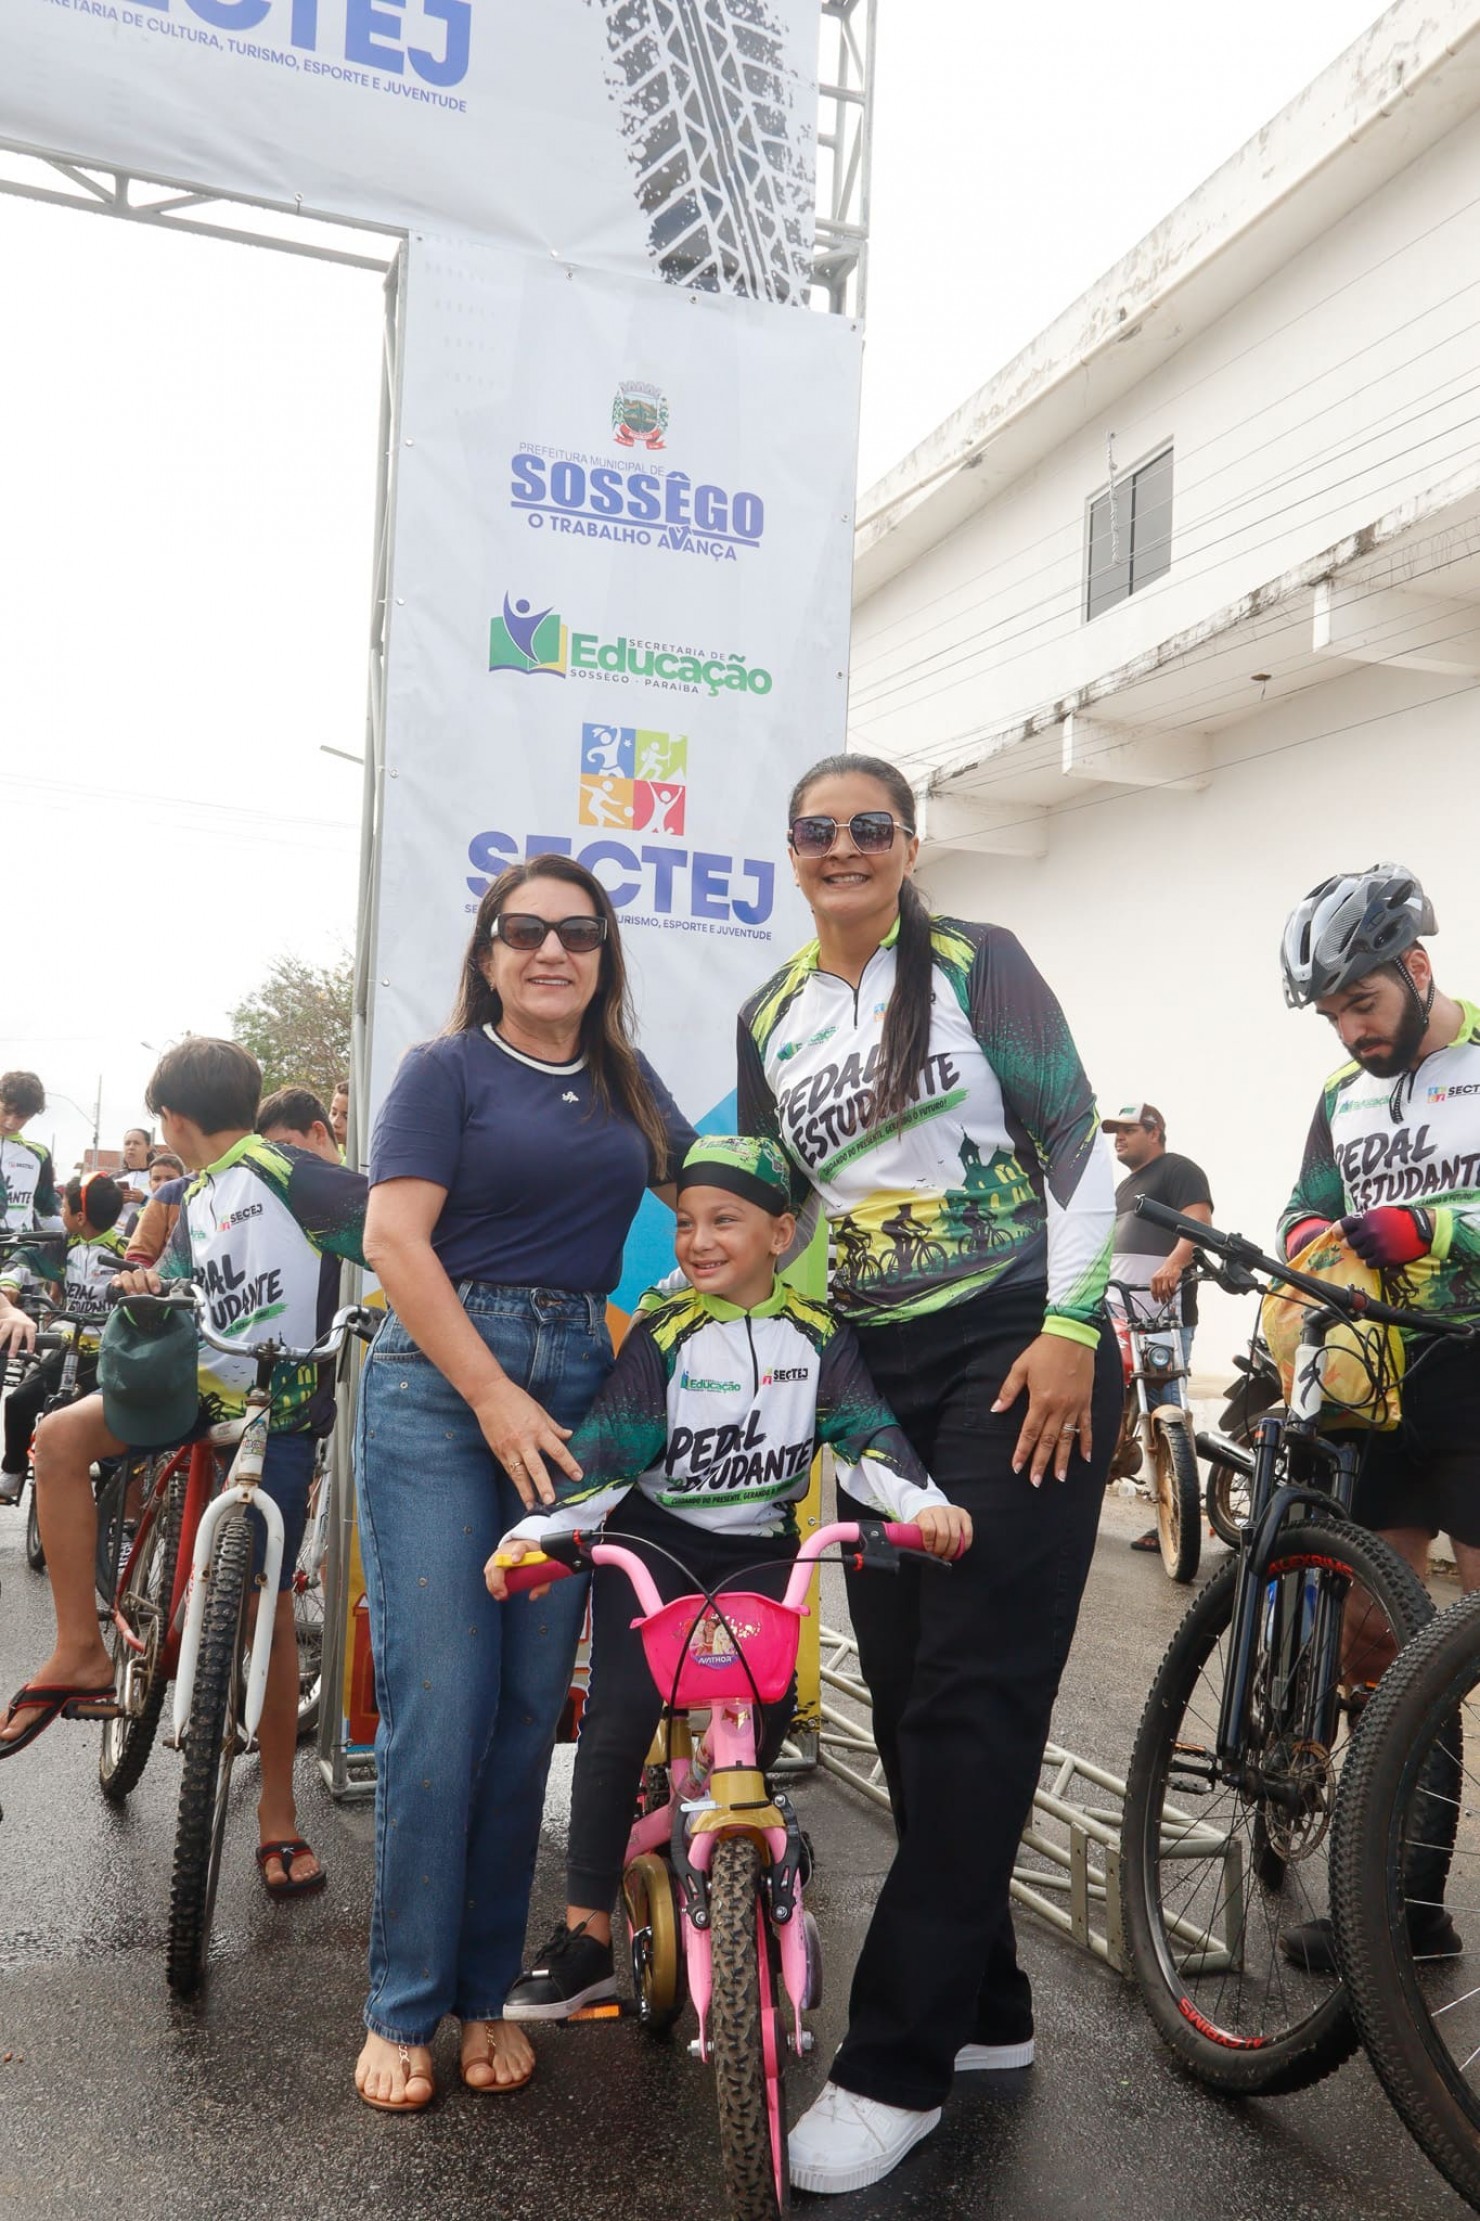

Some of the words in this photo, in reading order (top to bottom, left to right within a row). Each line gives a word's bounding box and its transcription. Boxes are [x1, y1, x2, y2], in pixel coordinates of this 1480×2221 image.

[122, 11, 143, 28] DE
[146, 18, 224, 51] CULTURA,
[227, 38, 300, 71] TURISMO,
[303, 59, 369, 87] ESPORTE
[372, 79, 381, 90] E
[383, 80, 467, 113] JUVENTUDE
[519, 442, 589, 464] PREFEITURA
[590, 455, 647, 474] MUNICIPAL
[650, 465, 665, 477] DE
[511, 453, 764, 539] SOSSÊGO
[528, 513, 543, 529] O
[549, 515, 651, 546] TRABALHO
[657, 524, 737, 563] AVANÇA
[571, 632, 773, 698] Educação
[629, 638, 706, 659] SECRETARIA
[710, 651, 727, 662] DE
[616, 914, 661, 929] URISMO,
[663, 918, 708, 933] ESPORTE
[709, 925, 716, 934] E
[717, 924, 772, 941] JUVENTUDE
